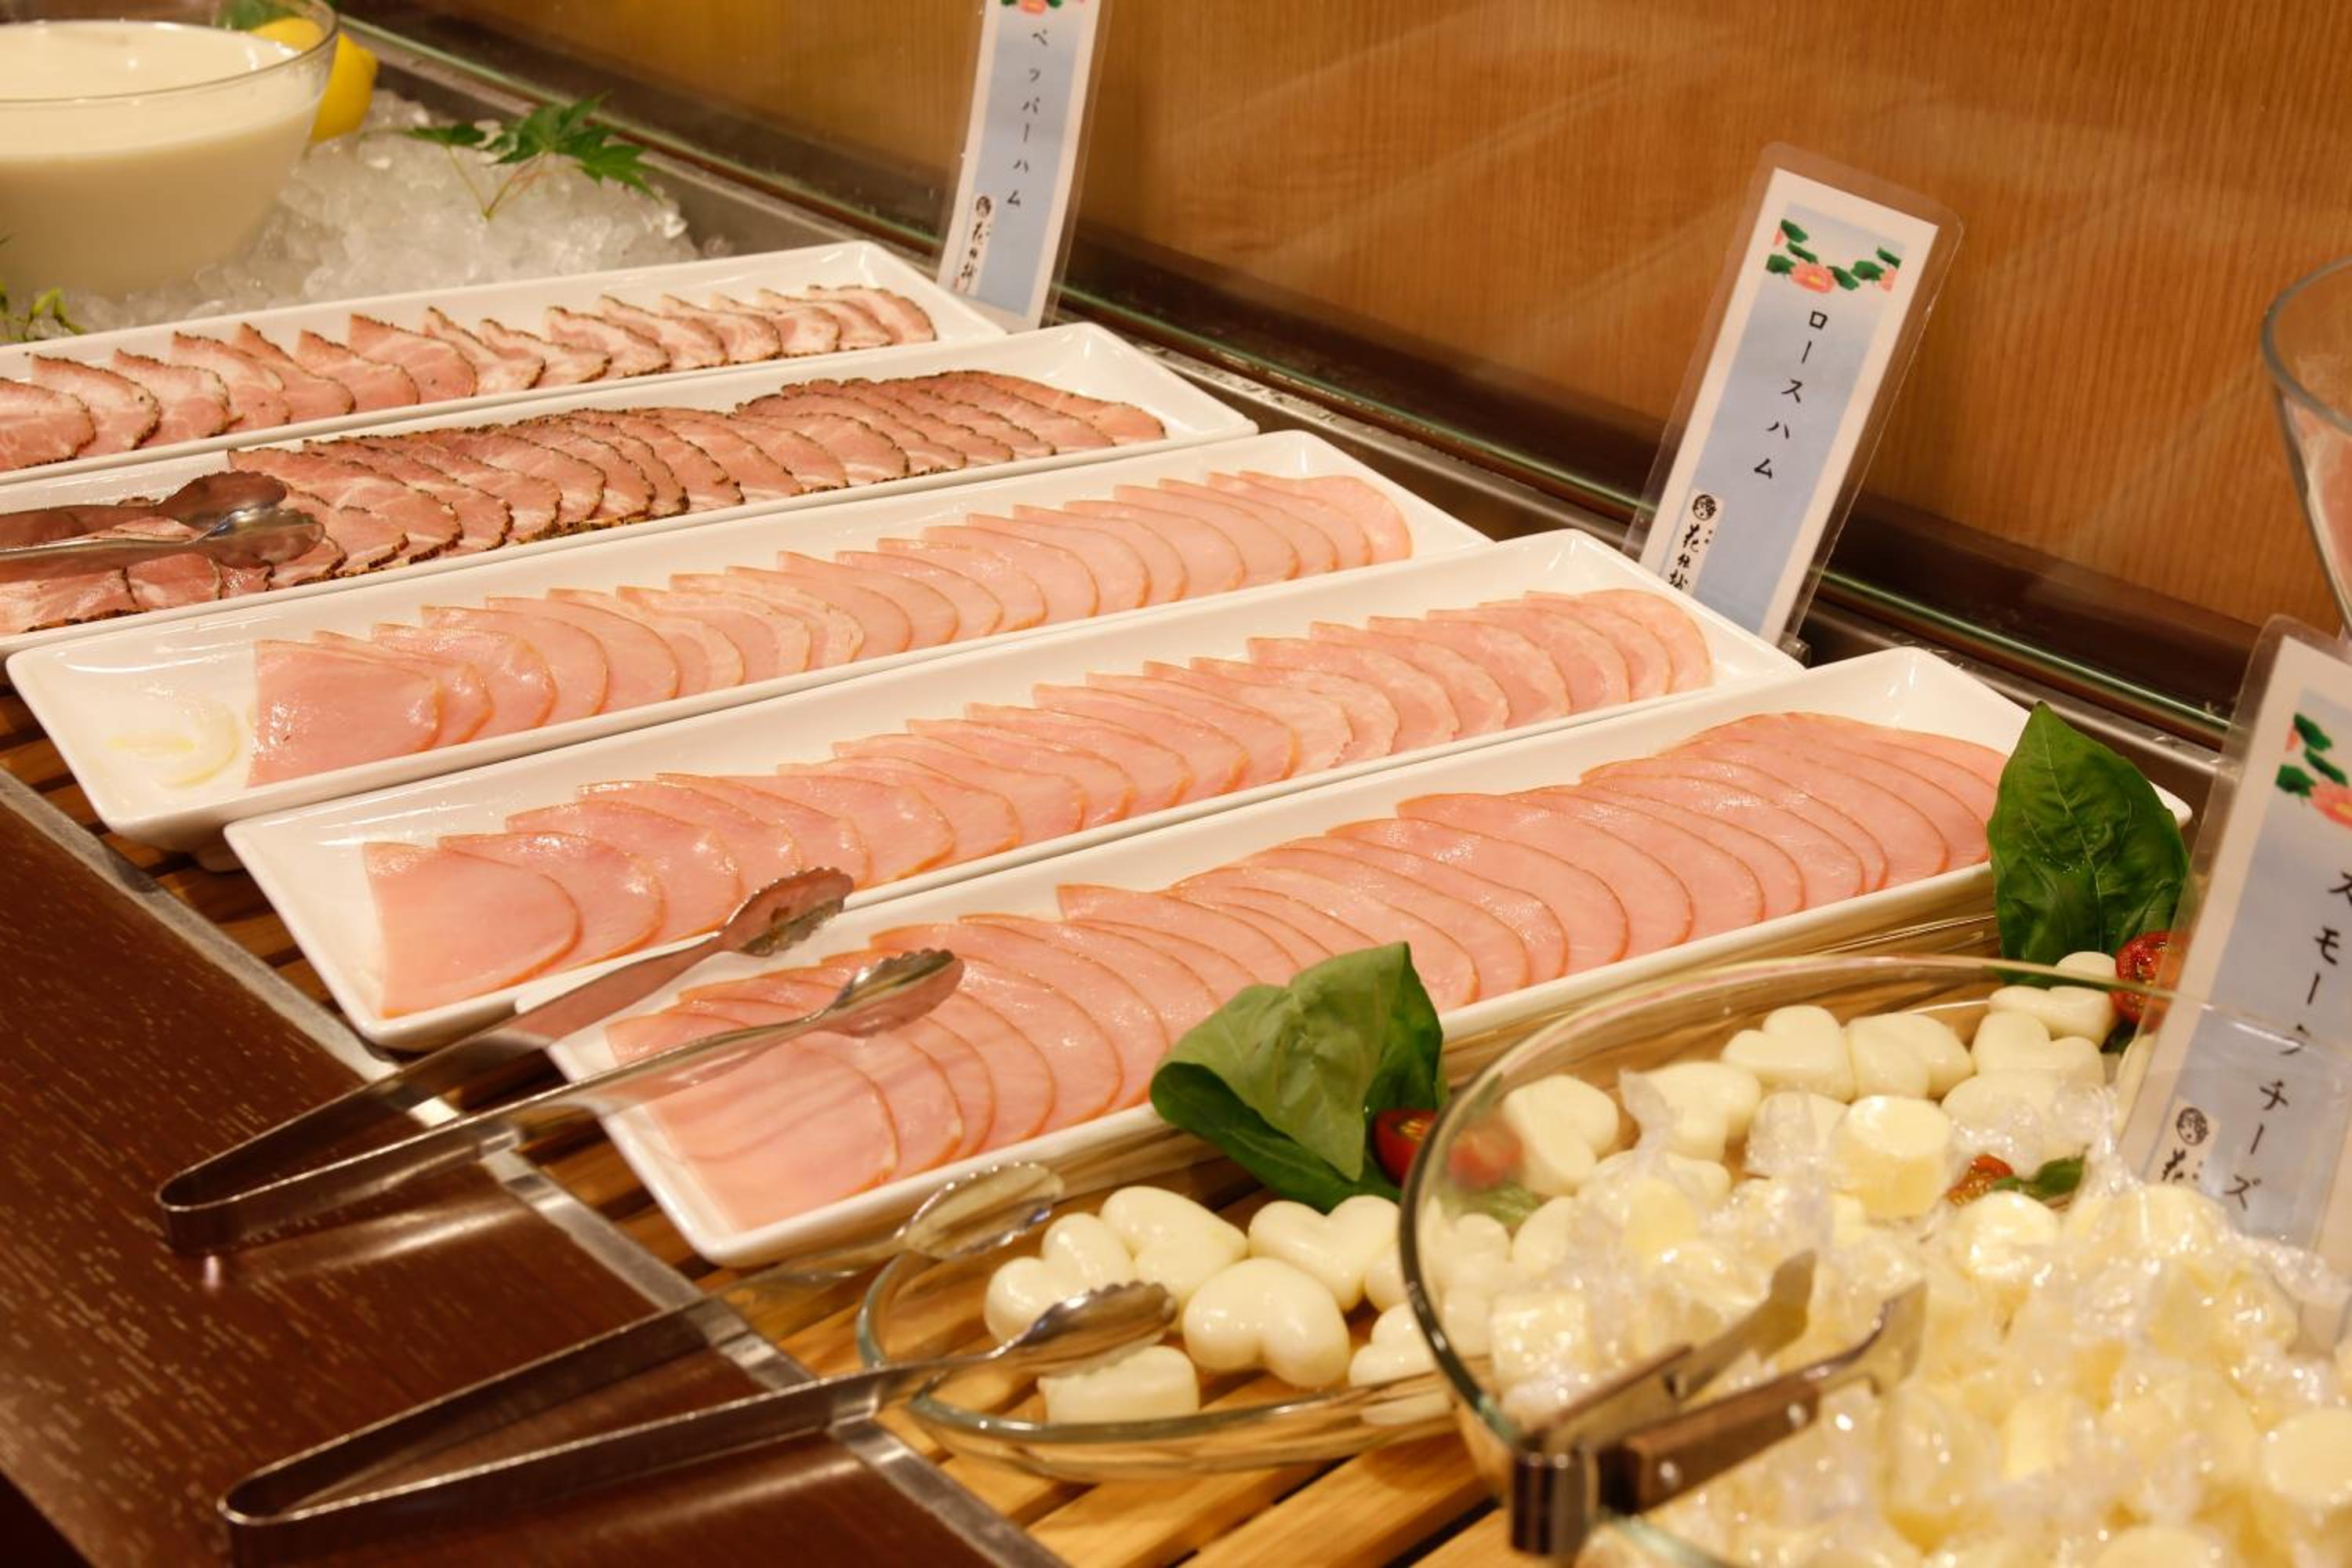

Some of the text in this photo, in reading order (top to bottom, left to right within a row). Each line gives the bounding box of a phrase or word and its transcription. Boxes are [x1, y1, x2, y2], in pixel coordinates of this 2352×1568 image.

[1754, 310, 1828, 479] ロースハム
